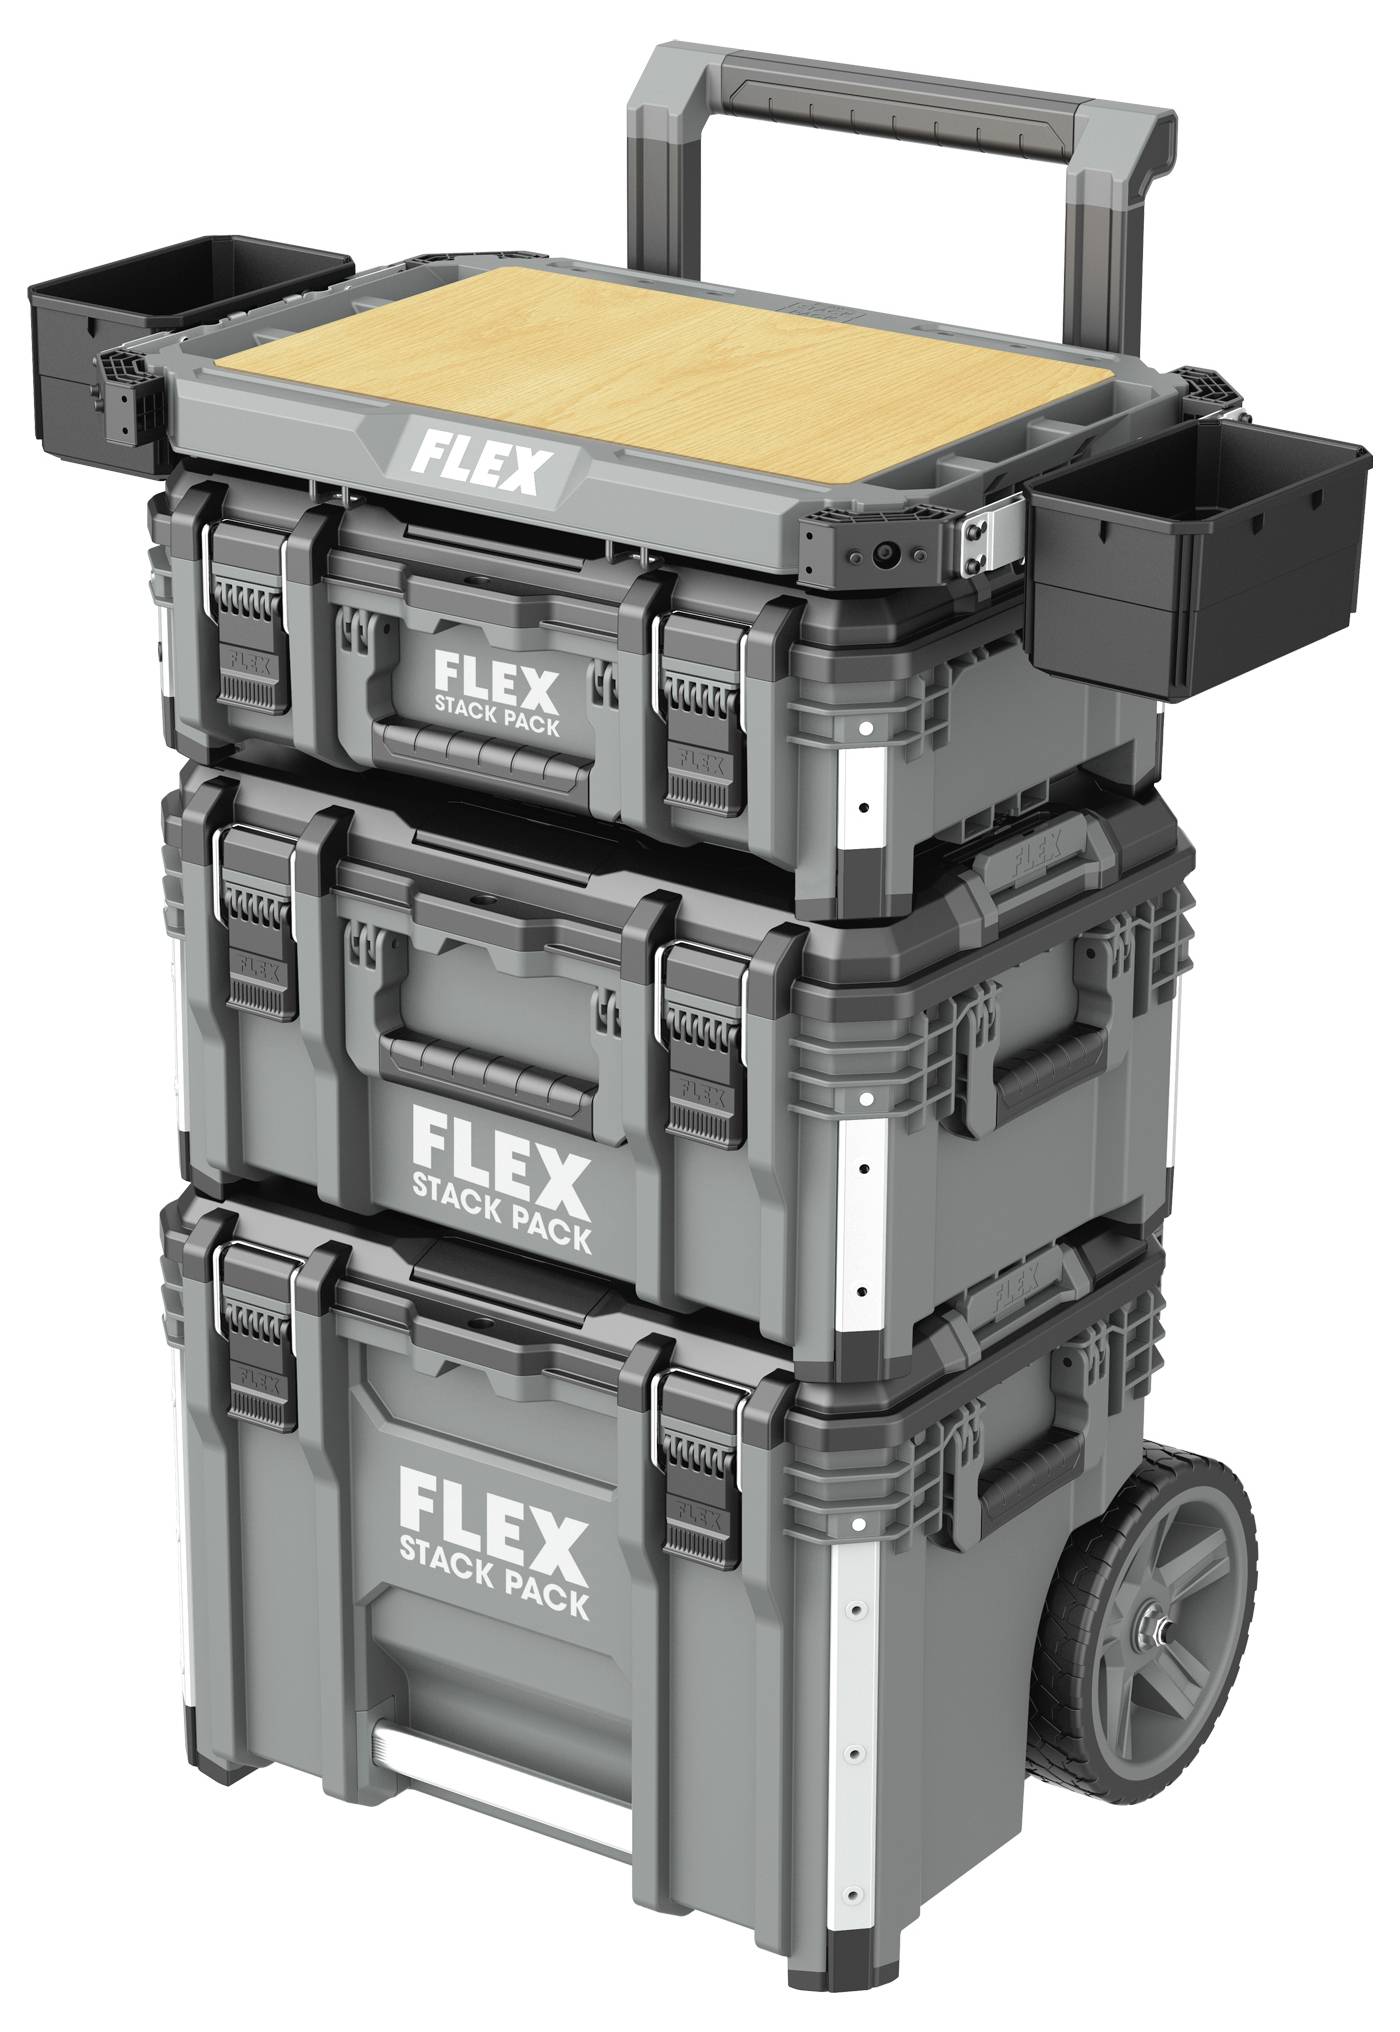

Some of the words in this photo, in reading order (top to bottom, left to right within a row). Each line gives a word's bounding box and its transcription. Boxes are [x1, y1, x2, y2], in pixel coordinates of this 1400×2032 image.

[410, 428, 555, 497] FLEX
[229, 650, 272, 675] FLEX
[435, 649, 560, 716] FLEX
[435, 694, 497, 723] STACK
[504, 709, 560, 738] PACK
[679, 749, 725, 777] FLEX
[1011, 828, 1062, 878] FLEX
[239, 955, 281, 983] FLEX
[680, 1079, 725, 1108] FLEX
[412, 1104, 592, 1223] FLEX
[412, 1171, 502, 1224] STACK
[512, 1204, 592, 1255] PACK
[992, 1260, 1039, 1314] FLEX
[240, 1367, 281, 1394] FLEX
[400, 1465, 589, 1589] FLEX
[678, 1502, 721, 1531] FLEX
[400, 1534, 494, 1589] STACK
[505, 1568, 590, 1621] PACK
